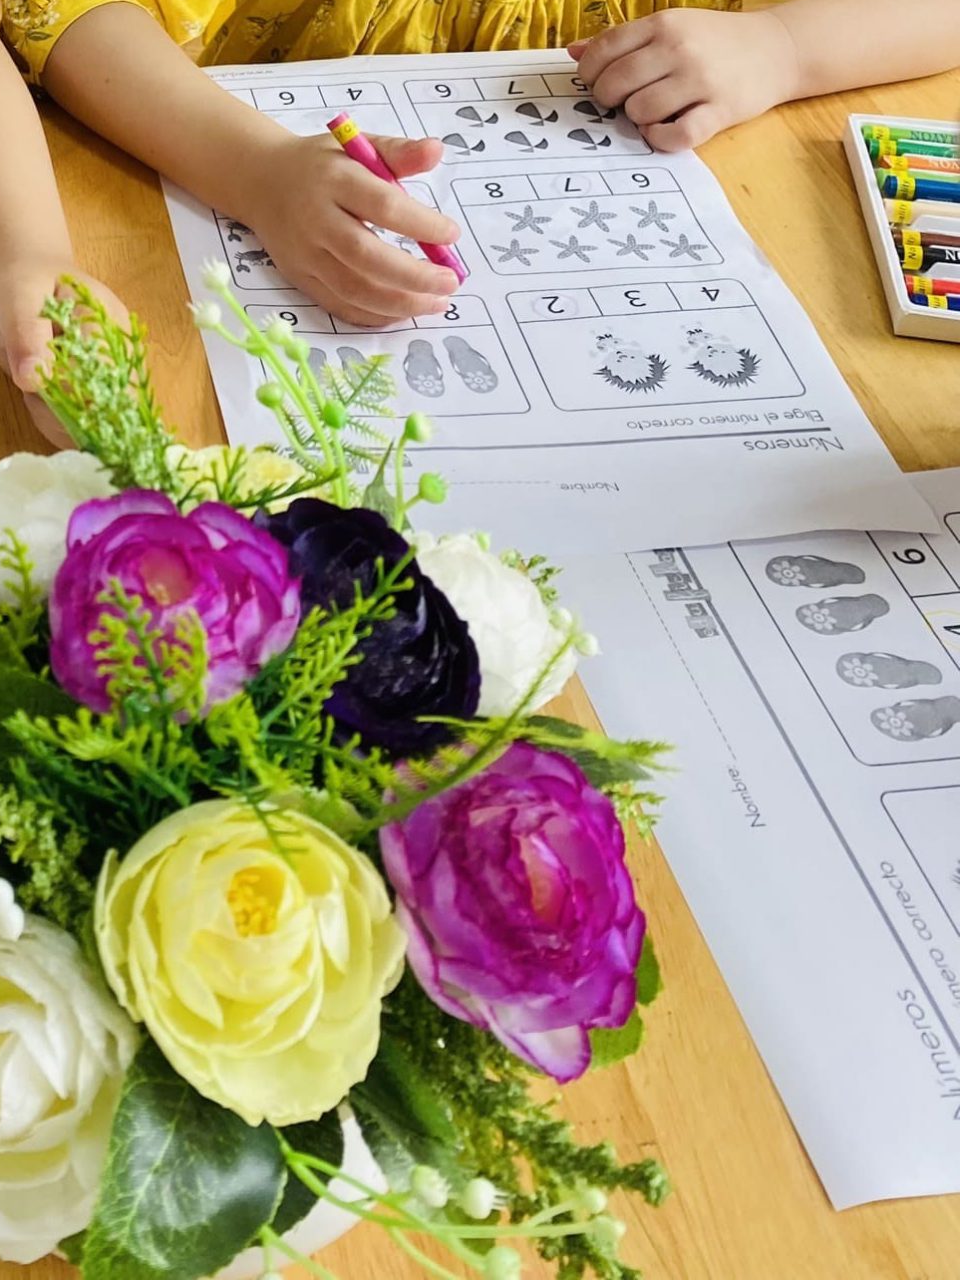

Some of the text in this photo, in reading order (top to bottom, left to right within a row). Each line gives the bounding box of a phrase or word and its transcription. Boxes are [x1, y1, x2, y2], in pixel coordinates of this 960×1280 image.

[435, 84, 451, 98] 6
[508, 81, 524, 94] 7
[279, 88, 362, 106] 4 6
[485, 173, 650, 199] 6 7 8
[542, 287, 719, 314] 4 3 2
[279, 312, 299, 327] 6
[626, 409, 824, 431] Elige el número correcto
[743, 436, 845, 452] Números
[880, 861, 932, 941] correcto
